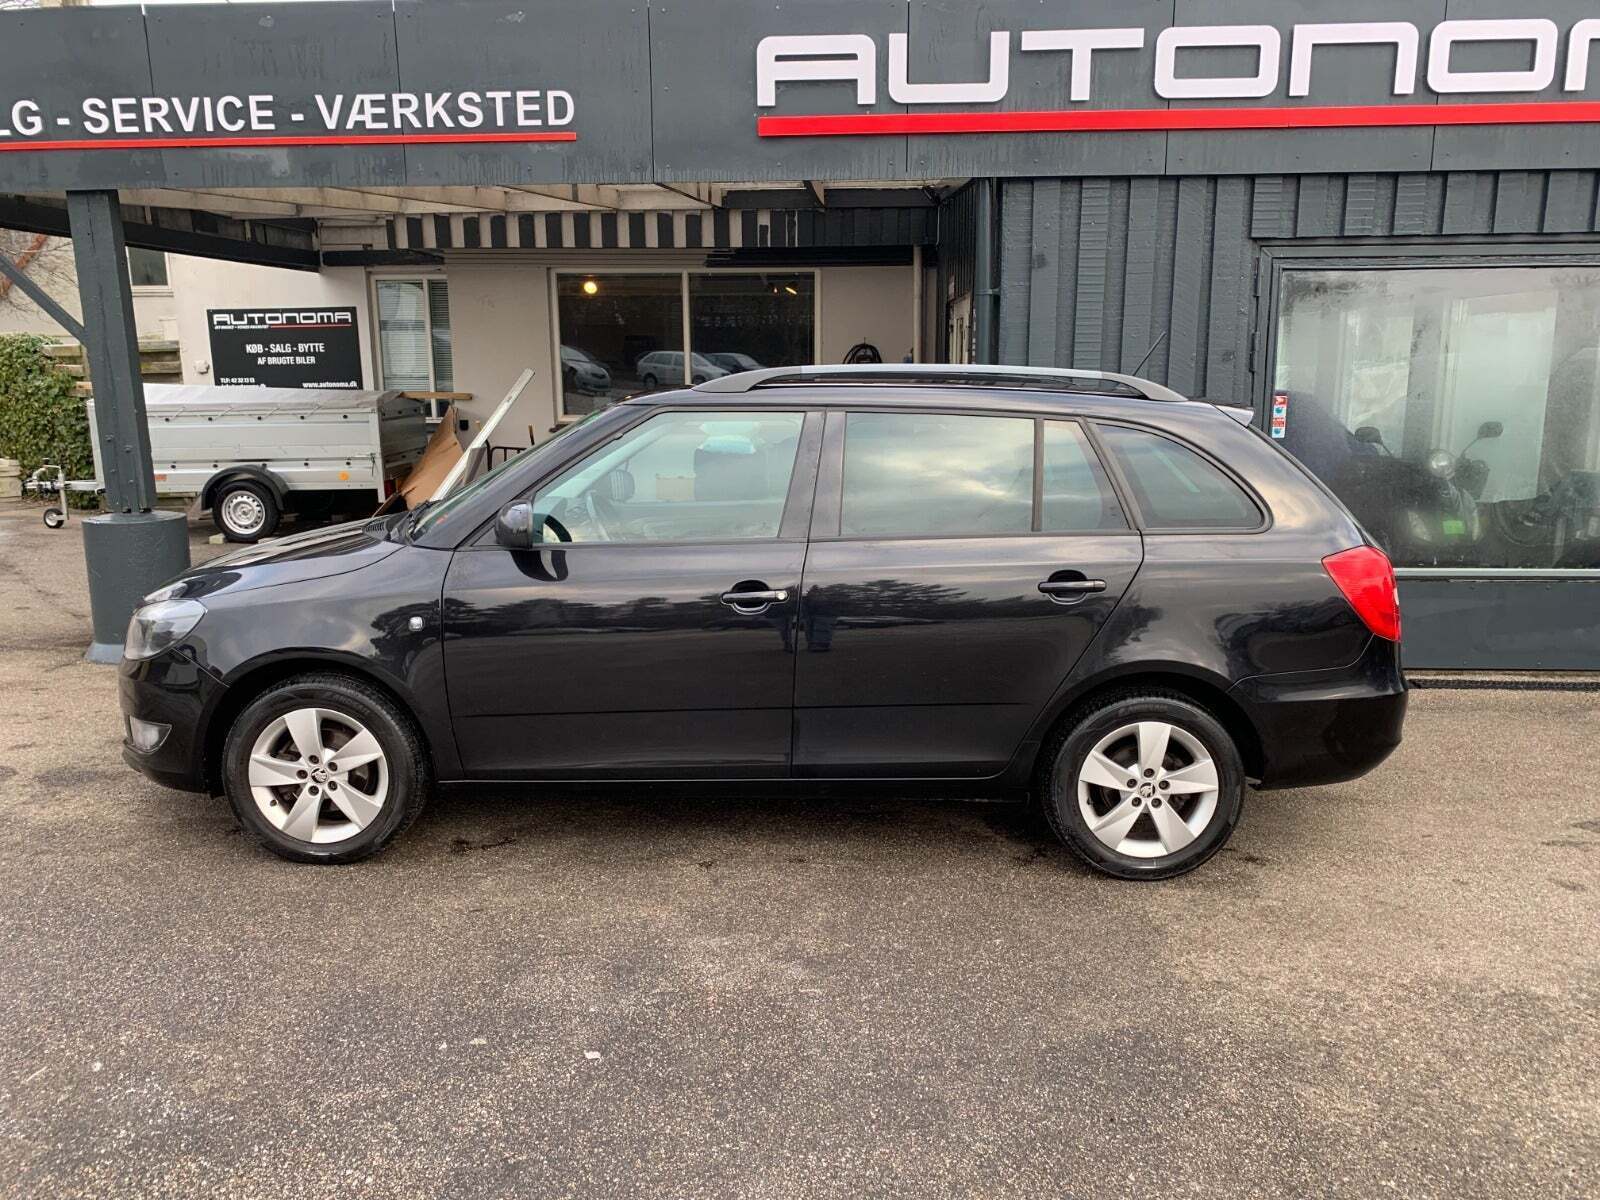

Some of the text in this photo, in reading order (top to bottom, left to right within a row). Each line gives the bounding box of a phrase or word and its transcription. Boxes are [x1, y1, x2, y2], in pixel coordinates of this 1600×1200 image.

[83, 94, 275, 135] SERVICE
[314, 90, 576, 131] VÆRKSTED
[213, 312, 352, 325] AUTONOMA
[245, 344, 263, 354] KØB
[270, 343, 292, 353] SALG
[298, 343, 325, 353] BYTTE
[257, 356, 316, 365] AF BRUGTE BILER
[302, 380, 358, 388] www.autonoma.dk
